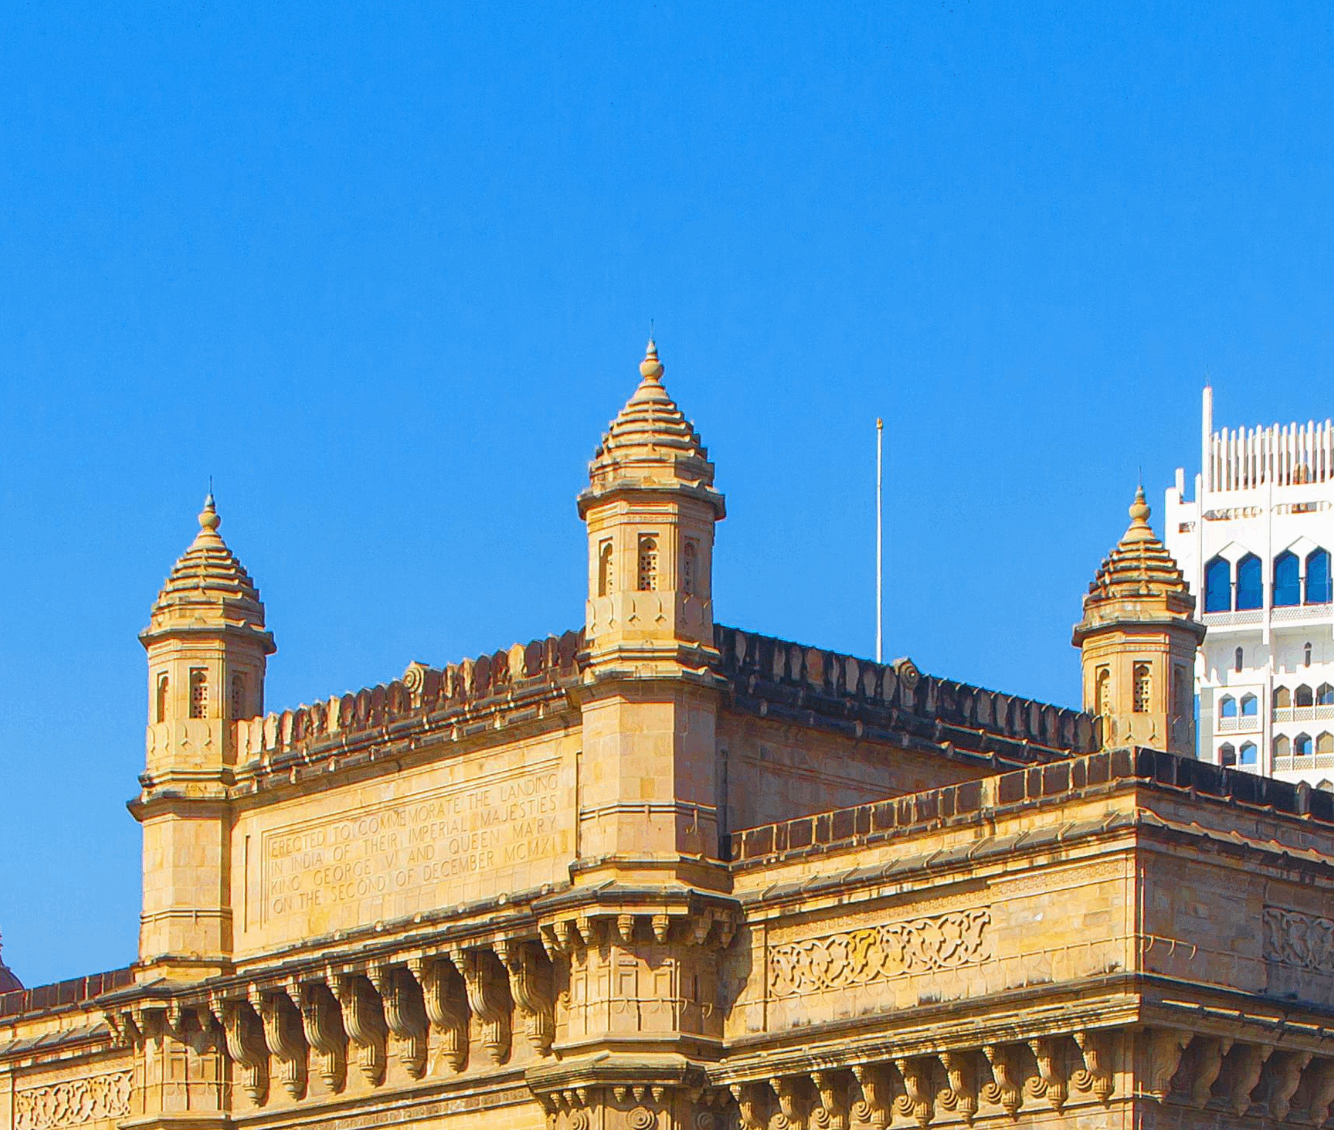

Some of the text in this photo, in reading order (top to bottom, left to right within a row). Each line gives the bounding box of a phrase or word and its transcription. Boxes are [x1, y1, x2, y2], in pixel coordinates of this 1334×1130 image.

[271, 773, 558, 858] ERECTED TO COMMEMORATE THE LANDING
[271, 795, 556, 877] IN INDIA OF THEIR IMPERIAL MAJESTIES
[271, 875, 300, 895] KING
[313, 859, 371, 886] GEORGE
[408, 844, 435, 864] AND
[448, 830, 500, 855] QUEEN
[513, 816, 556, 839] MARY
[273, 837, 555, 914] ON THE SECOND OF DECEMBER MCMXI
